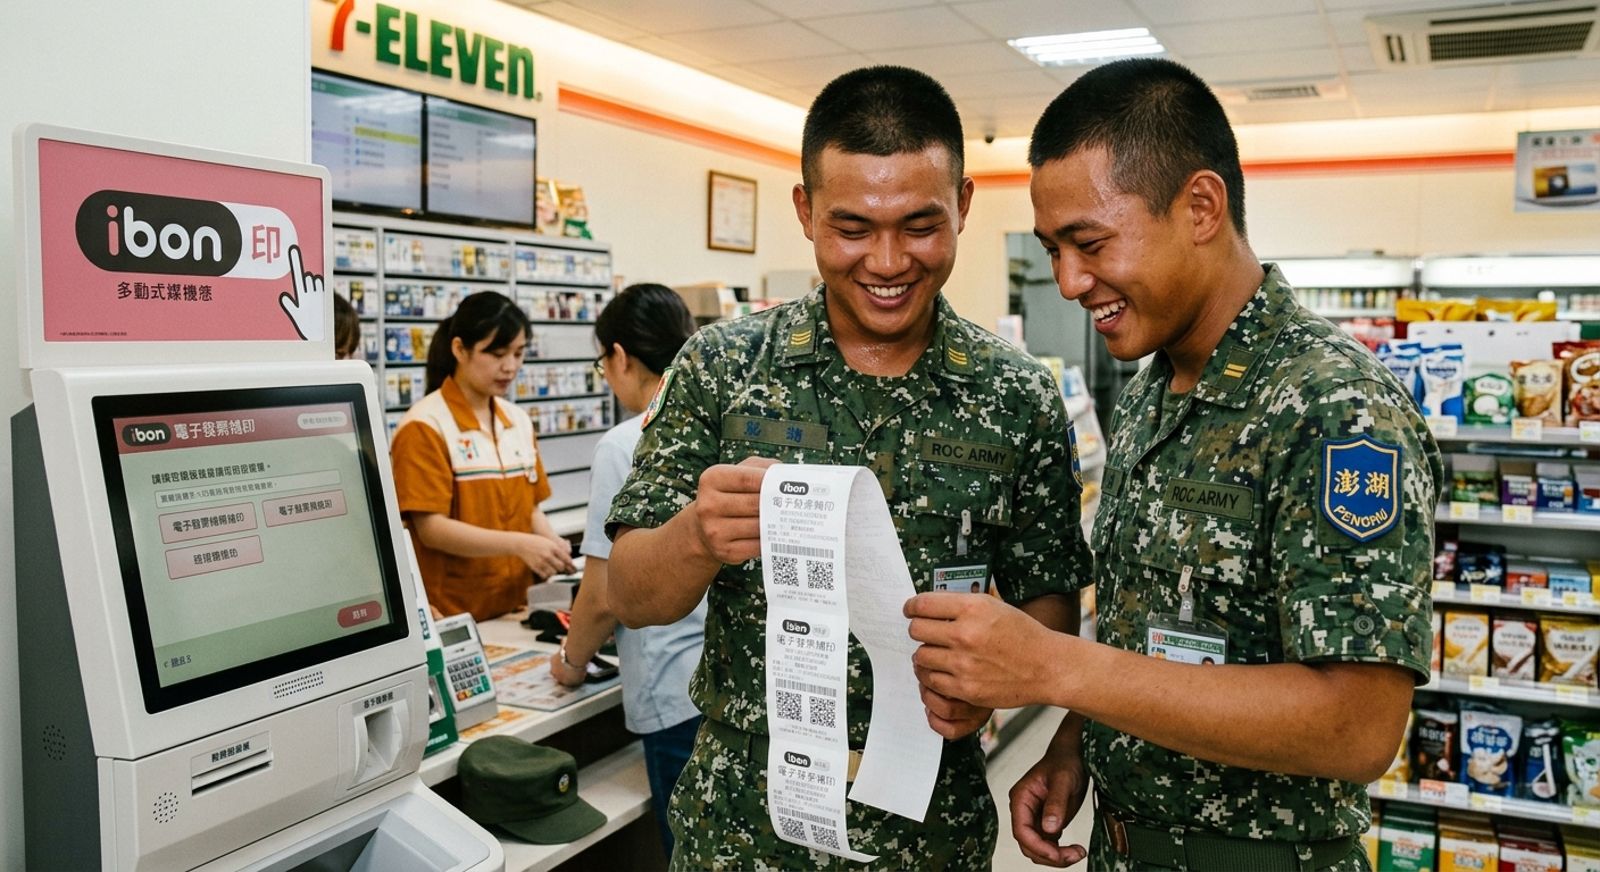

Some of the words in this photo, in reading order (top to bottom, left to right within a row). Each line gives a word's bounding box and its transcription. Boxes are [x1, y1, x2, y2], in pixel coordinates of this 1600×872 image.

[106, 204, 223, 262] ibon
[252, 224, 281, 264] 印
[131, 427, 166, 442] ibon
[932, 443, 964, 459] ROC
[967, 448, 1007, 465] ARMY
[1333, 468, 1390, 499] 澎湖
[1171, 485, 1196, 503] ROC
[1196, 490, 1240, 510] ARMY
